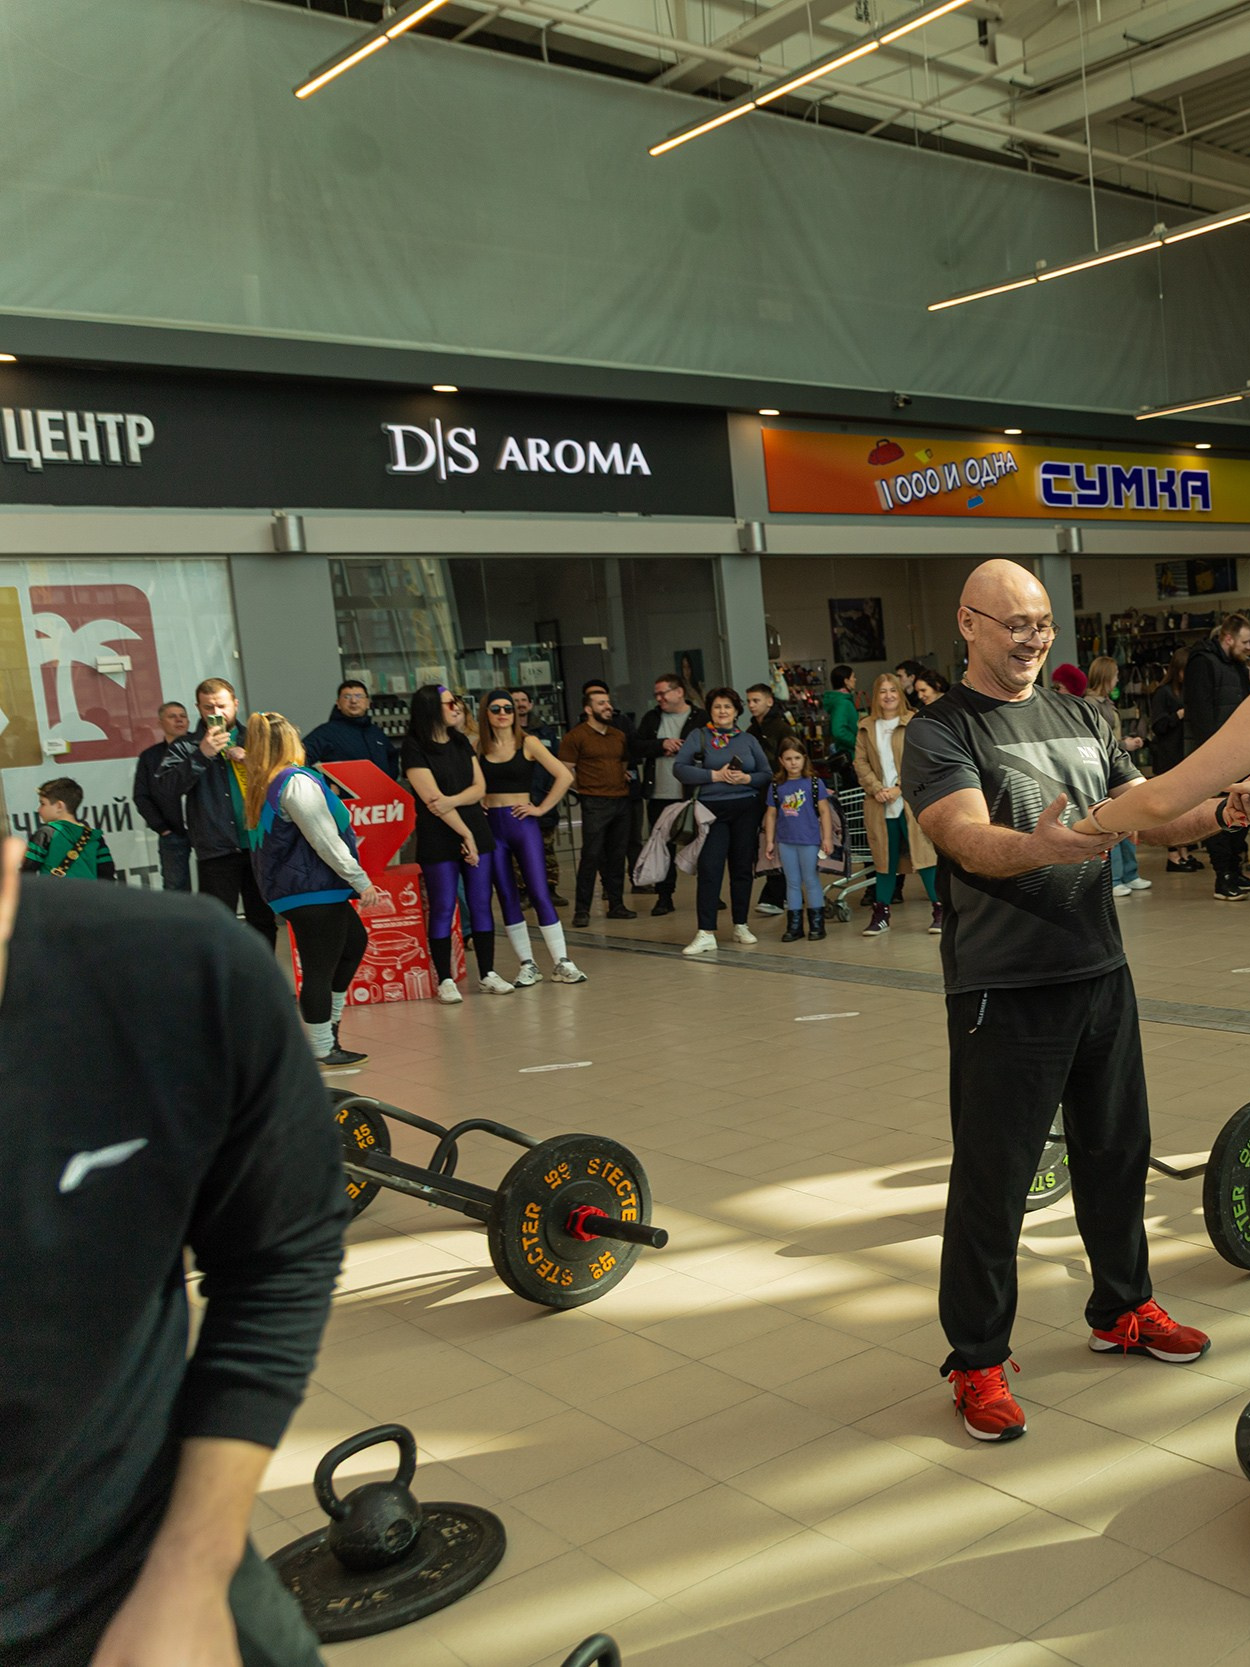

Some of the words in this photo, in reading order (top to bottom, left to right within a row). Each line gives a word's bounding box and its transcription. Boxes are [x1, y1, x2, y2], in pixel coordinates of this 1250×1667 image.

[2, 407, 155, 470] ЦЕНТР
[498, 435, 652, 476] AROMA
[942, 461, 962, 492] И
[964, 450, 1019, 489] ОДНА
[1040, 461, 1212, 512] СУМКА
[353, 1123, 372, 1142] 15
[357, 1135, 376, 1150] KG
[544, 1169, 563, 1190] 15
[586, 1158, 638, 1222] STECTE
[521, 1202, 574, 1287] STECTER
[598, 1250, 617, 1273] 15
